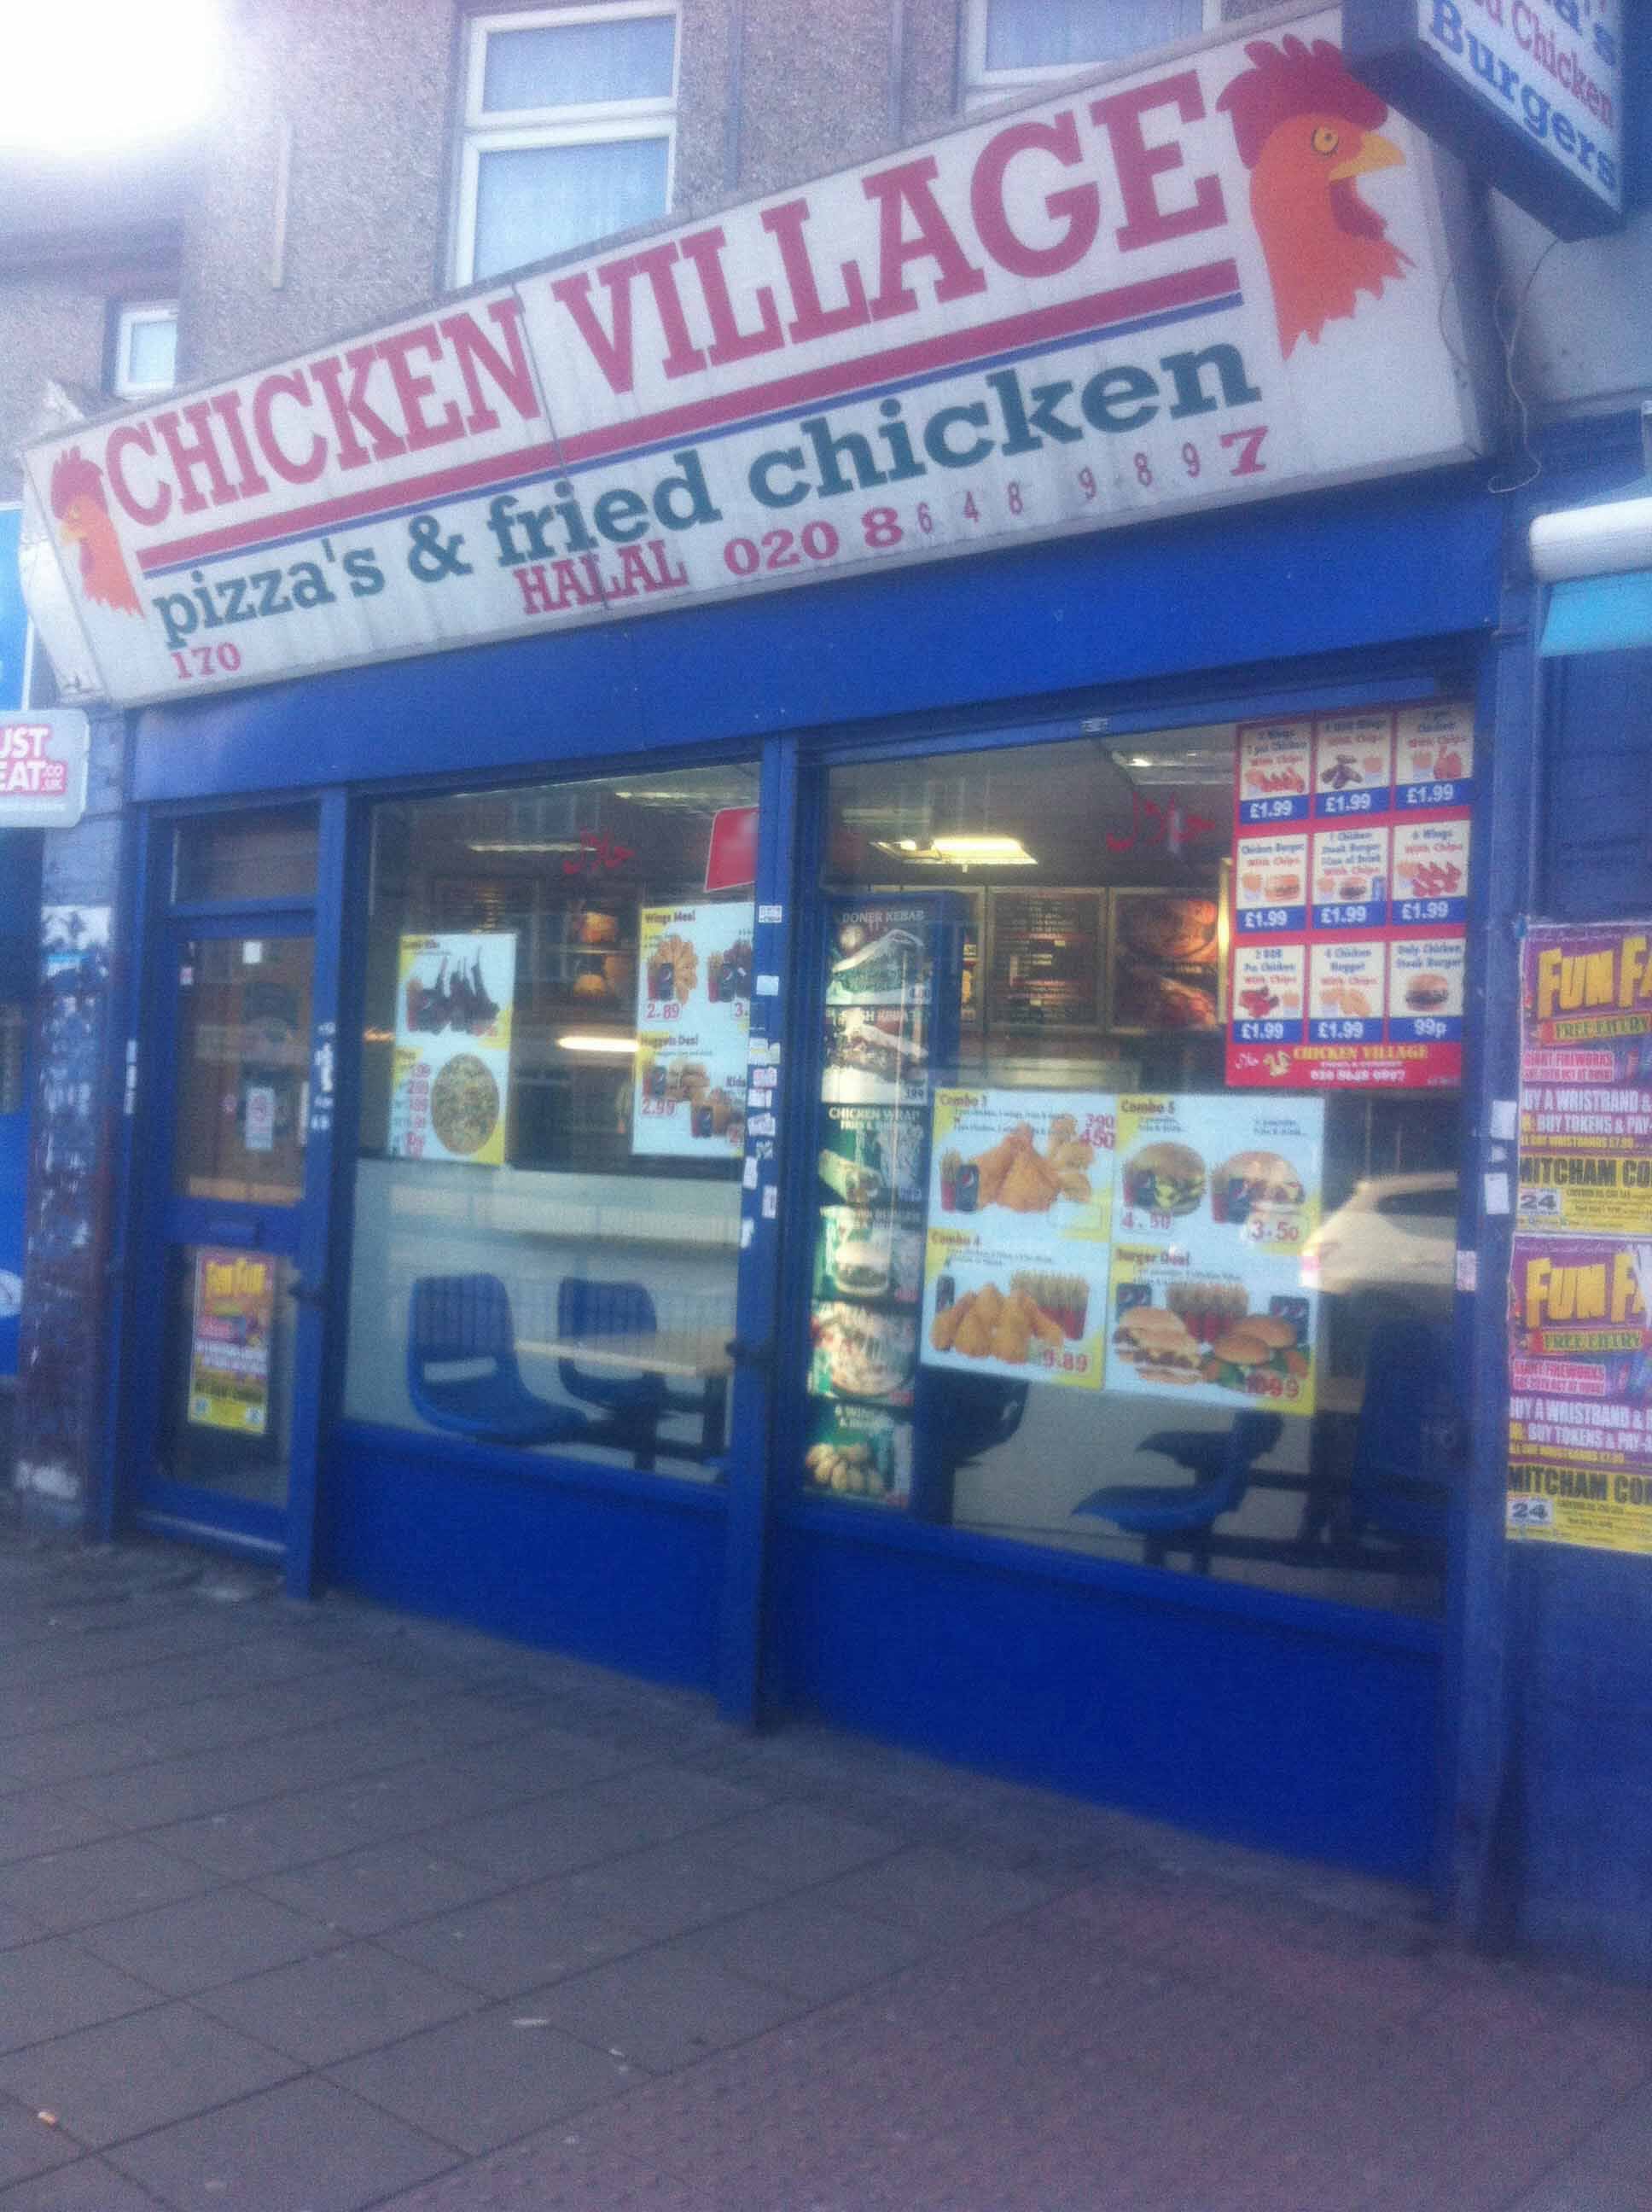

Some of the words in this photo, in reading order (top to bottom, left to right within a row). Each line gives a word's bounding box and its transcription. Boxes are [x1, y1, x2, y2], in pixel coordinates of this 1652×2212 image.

[1428, 0, 1617, 192] Burgers
[104, 286, 544, 527] CHICKEN
[551, 68, 1229, 395] VILLAGE
[152, 537, 385, 648] pizza's
[406, 513, 472, 585] &
[486, 449, 722, 568] fried
[747, 343, 1263, 509] chicken
[514, 538, 688, 616] HALAL
[723, 520, 841, 576] 020
[171, 641, 243, 681] 170
[1324, 793, 1371, 813] £1.99
[1405, 783, 1454, 804] £1.99
[1249, 799, 1293, 819] £1.99
[1244, 910, 1288, 928] £1.99
[1321, 905, 1367, 924] £1.99
[1401, 901, 1449, 921] £1.99
[1537, 947, 1614, 1021] FUN
[1240, 1022, 1284, 1039] £1.99
[1317, 1022, 1364, 1039] £1.99
[1545, 1091, 1556, 1112] A
[1556, 1090, 1638, 1113] WRISTBAND
[1537, 1115, 1561, 1134] BUY
[1564, 1115, 1612, 1134] TOKENS
[1520, 1195, 1556, 1211] 24
[1525, 1257, 1607, 1331] FUN
[1542, 1331, 1583, 1352] FREE
[1534, 1400, 1545, 1421] A
[1546, 1400, 1630, 1429] WRISTBAND
[1527, 1423, 1554, 1441] BUY
[1555, 1424, 1603, 1450] TOKENS
[1511, 1502, 1550, 1521] 24
